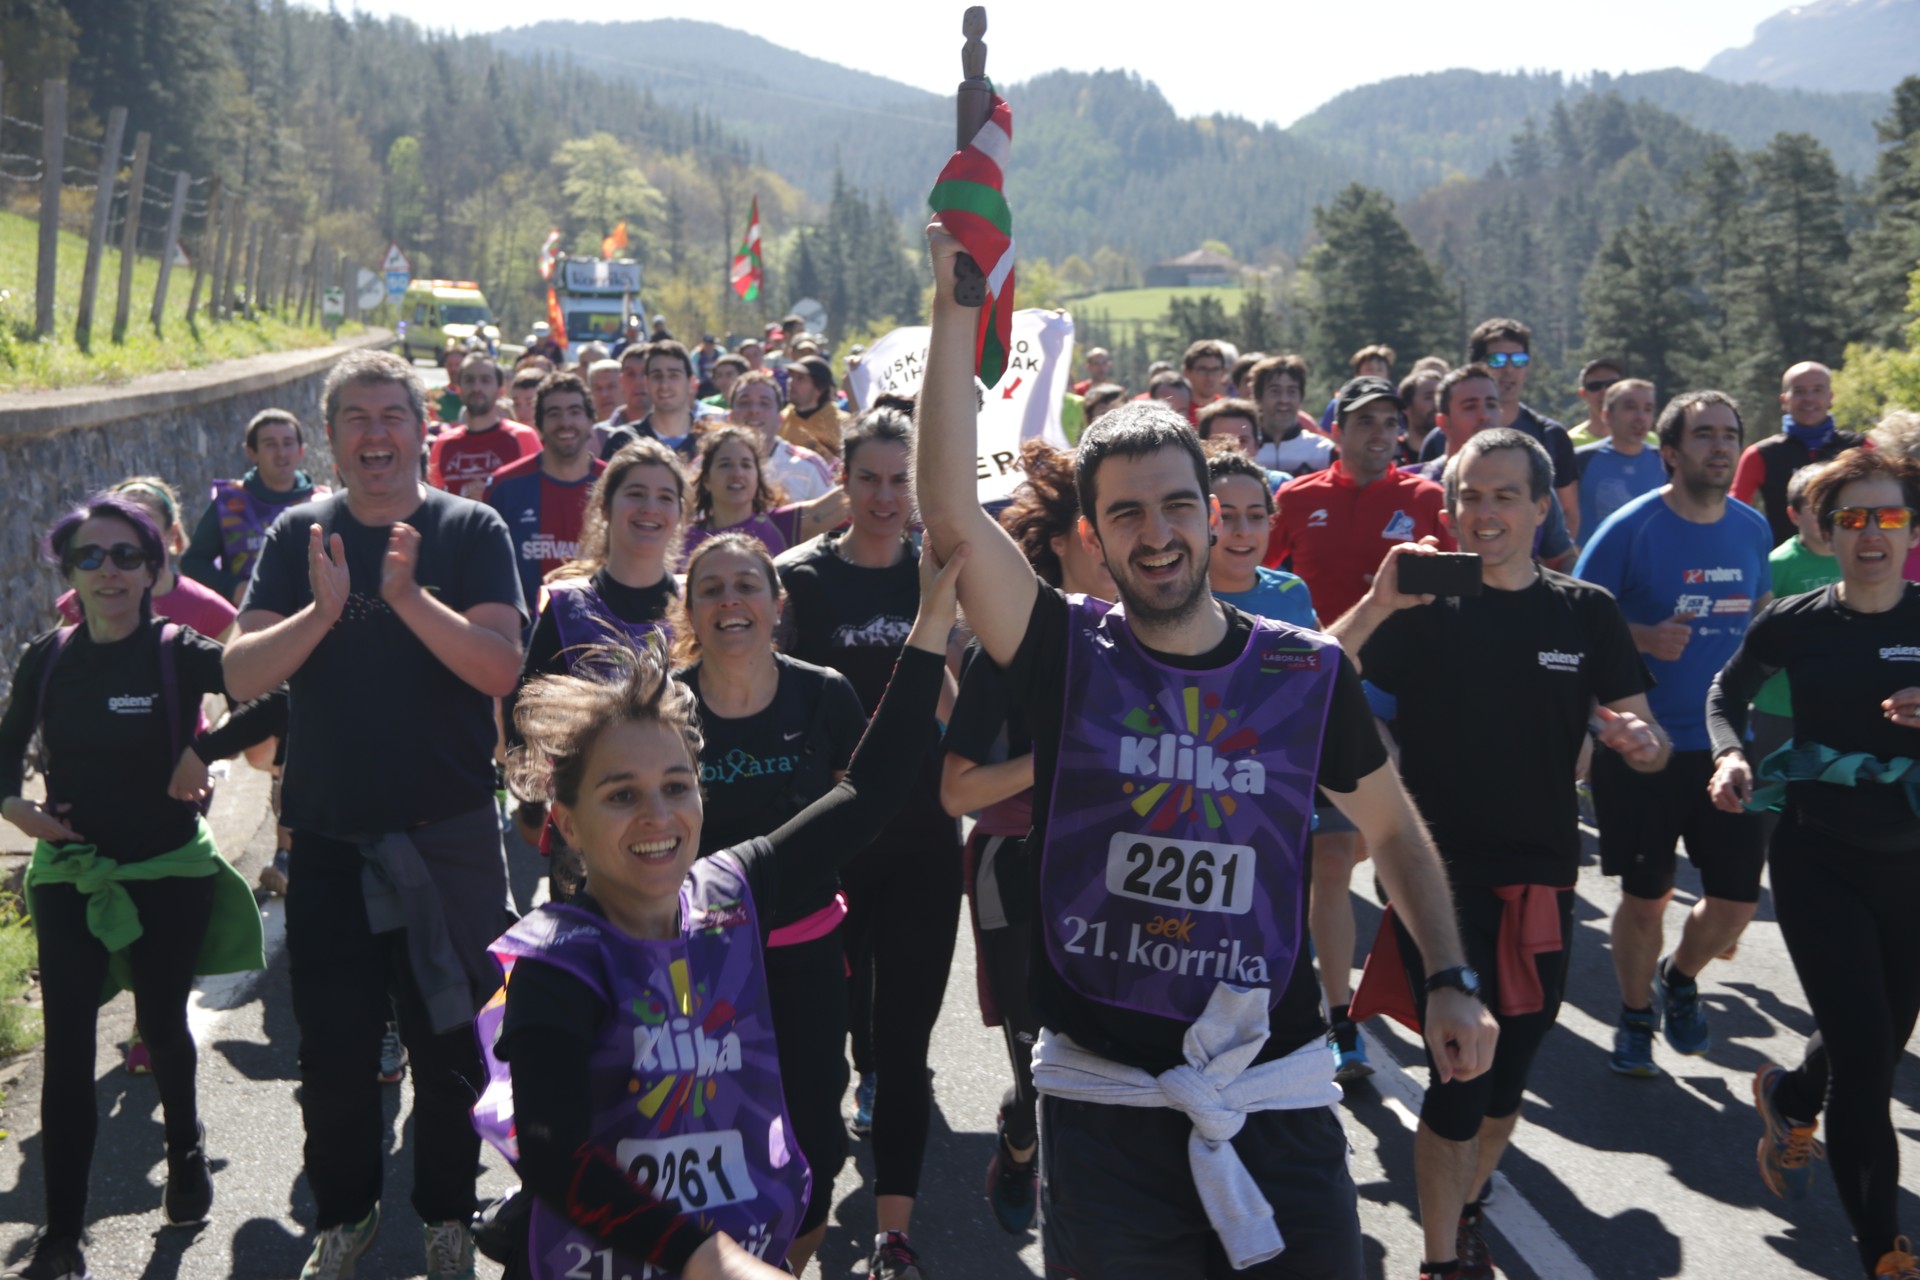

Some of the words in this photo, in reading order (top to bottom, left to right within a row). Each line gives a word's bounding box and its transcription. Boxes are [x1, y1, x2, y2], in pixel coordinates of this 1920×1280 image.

[1263, 653, 1306, 663] LABORAL
[1538, 649, 1580, 666] goiena
[108, 693, 153, 711] goiena
[1118, 733, 1266, 795] Klika
[1122, 842, 1239, 908] 2261
[1146, 912, 1197, 943] aek
[1063, 916, 1119, 961] 21.
[1127, 923, 1271, 983] korrika
